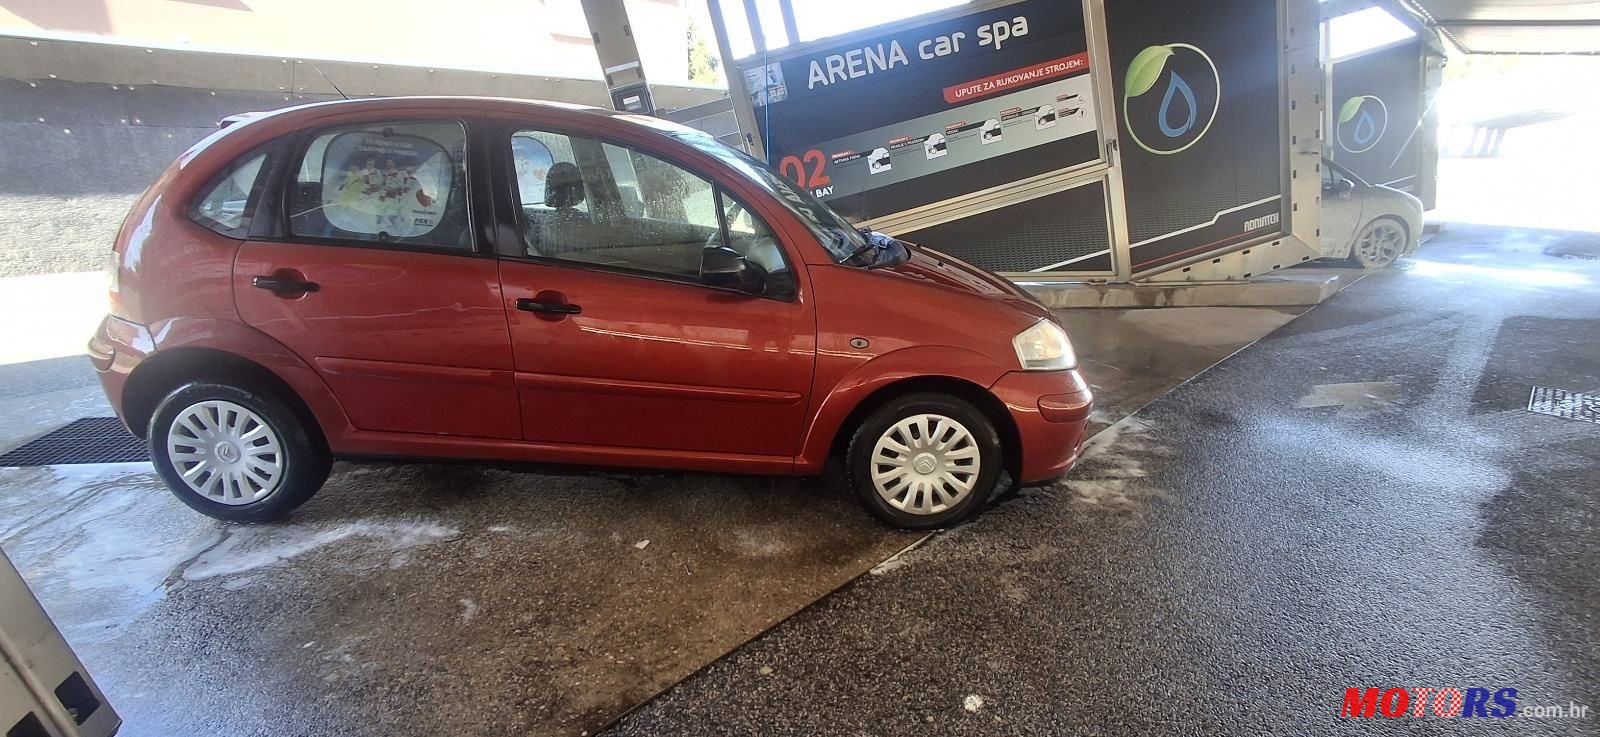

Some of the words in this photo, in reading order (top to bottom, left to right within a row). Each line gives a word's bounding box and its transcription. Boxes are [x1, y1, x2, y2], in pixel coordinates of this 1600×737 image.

[808, 40, 909, 89] ARENA
[918, 31, 966, 60] car
[976, 15, 1029, 50] spa
[955, 84, 983, 98] UPUTE
[983, 82, 996, 91] ZA
[996, 69, 1044, 88] RUKOVANJE
[1045, 58, 1084, 75] STROJEM:
[815, 186, 834, 198] BAY
